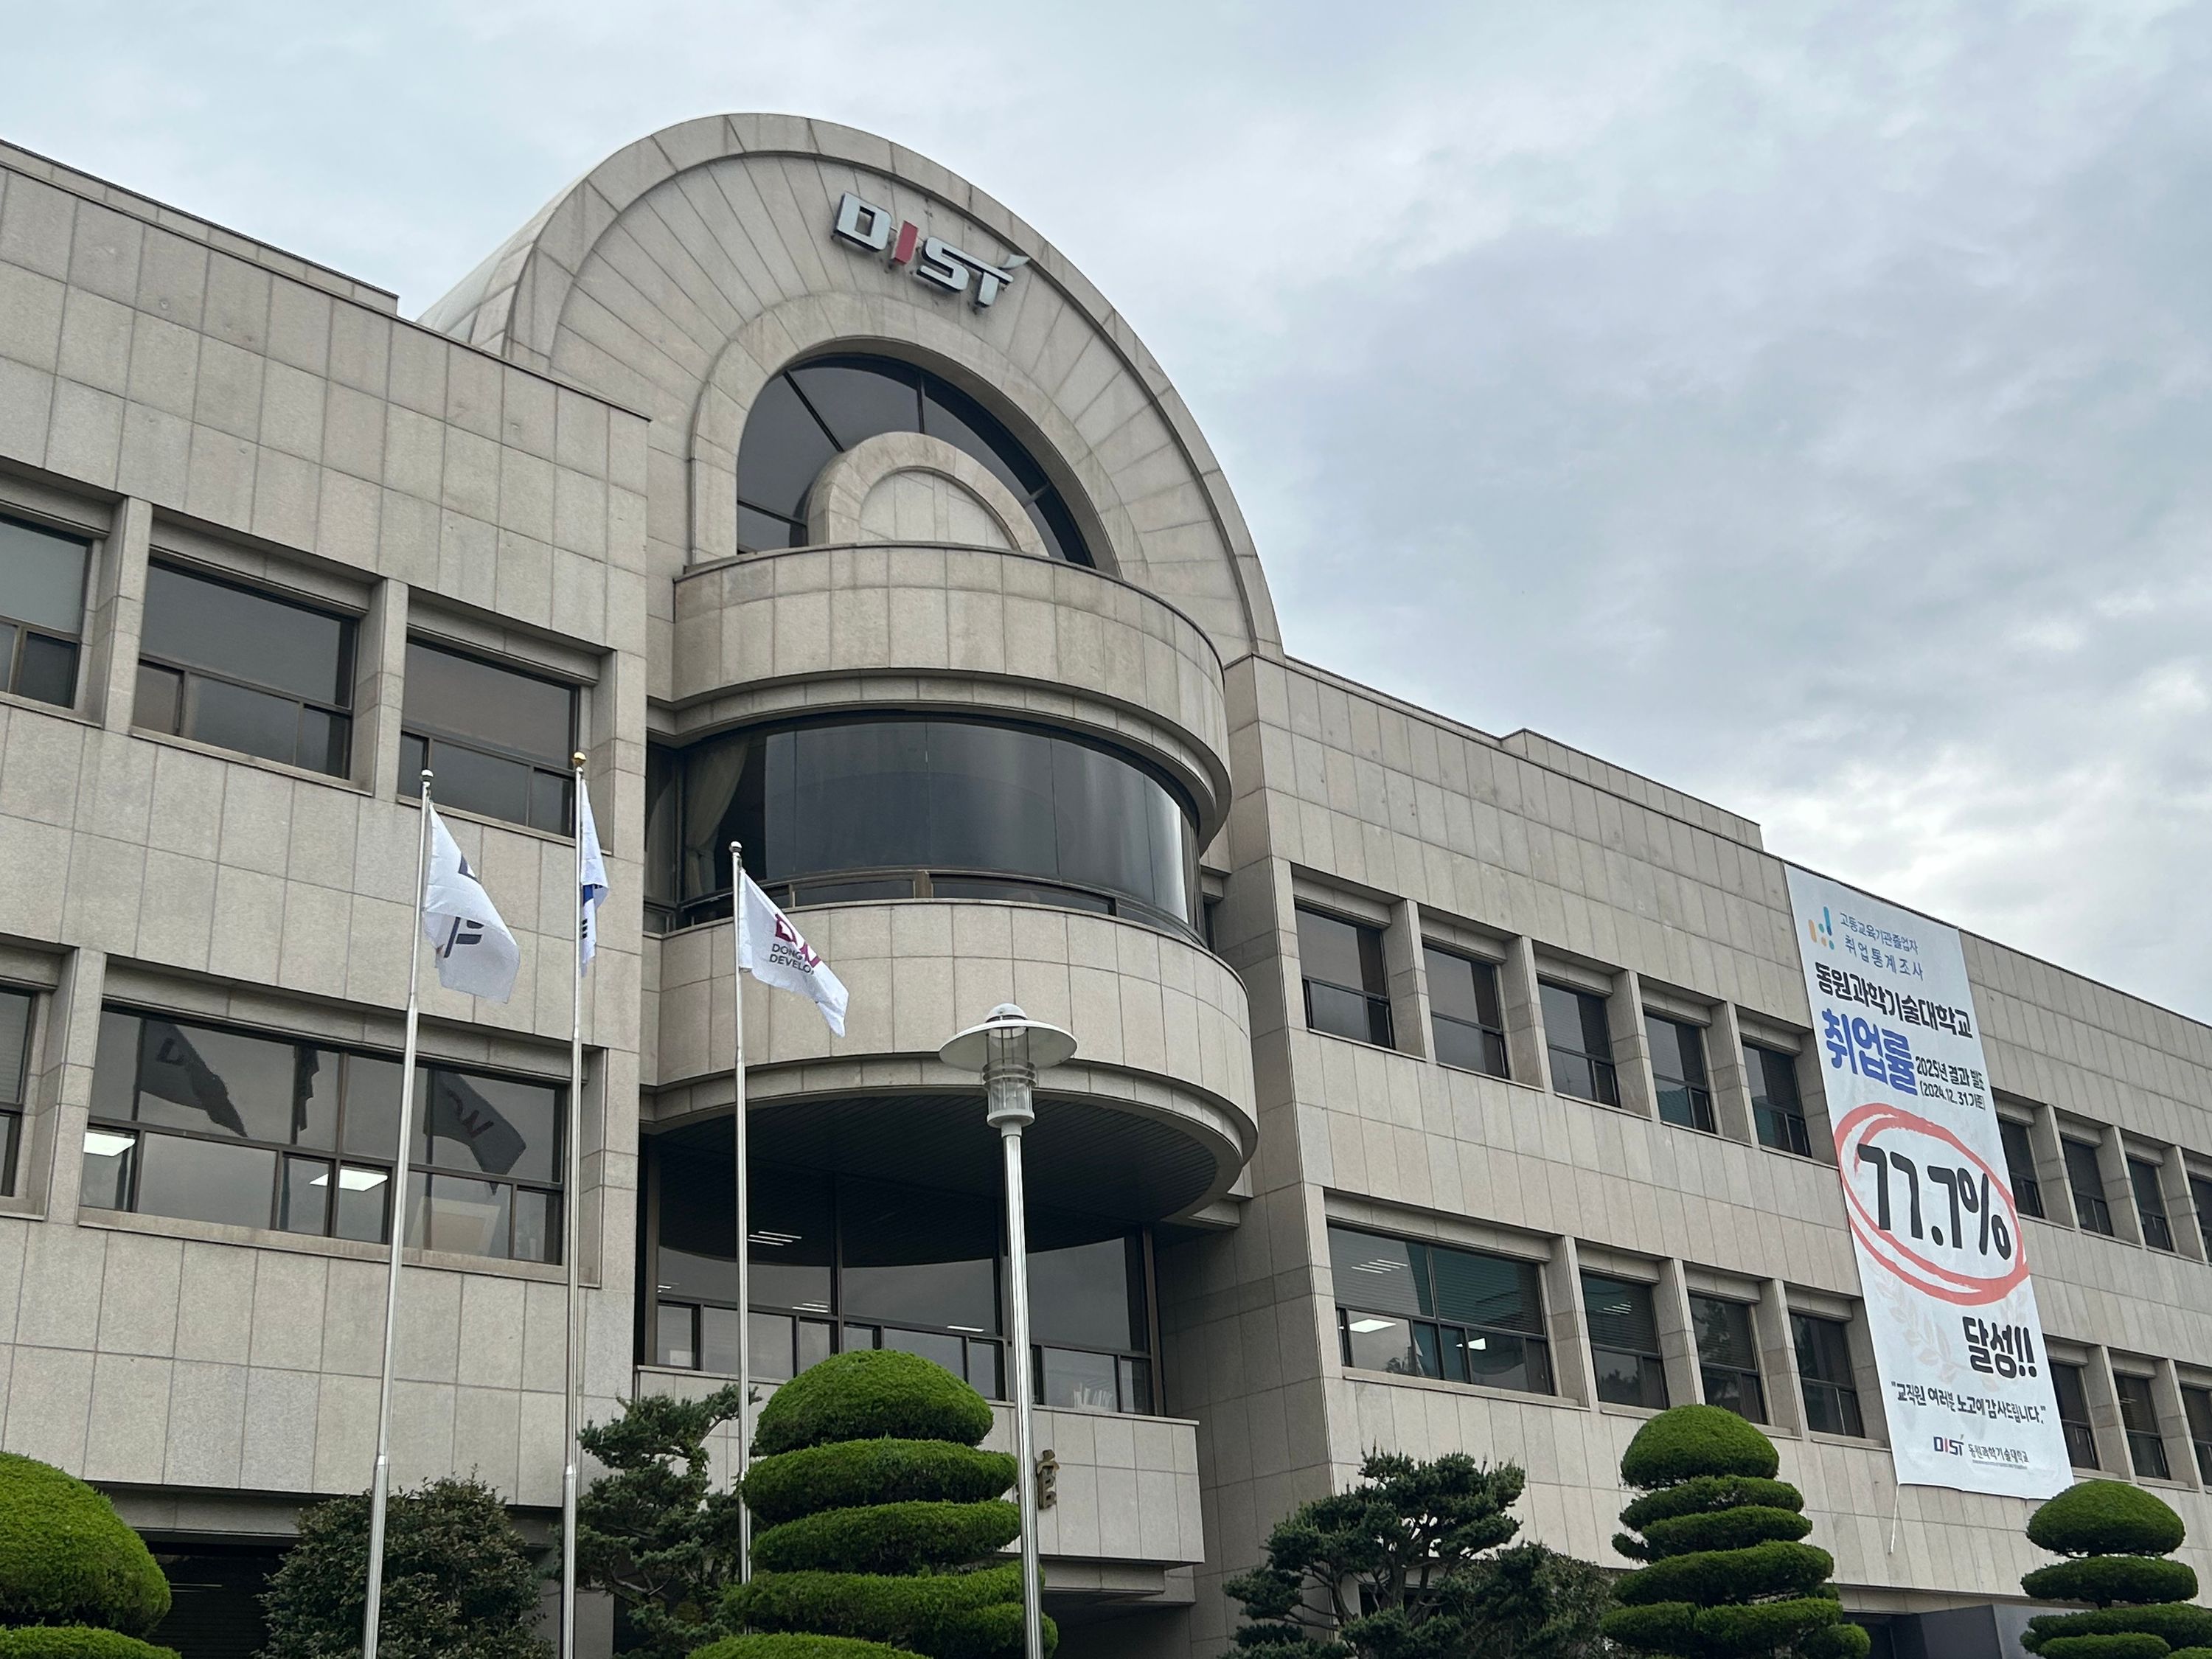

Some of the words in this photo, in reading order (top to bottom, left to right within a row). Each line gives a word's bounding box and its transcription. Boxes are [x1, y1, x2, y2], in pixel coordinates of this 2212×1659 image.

[834, 191, 1030, 307] DIST
[772, 943, 803, 960] DONG
[1840, 912, 1918, 955] 고등교육기관졸업자
[769, 953, 814, 975] DEVELO
[1815, 961, 1973, 1038] 동원과학기술대학교
[1822, 1008, 1918, 1096] 취업률
[1916, 1056, 1948, 1082] 2025년
[1948, 1065, 1970, 1087] 결과
[1857, 1143, 2011, 1260] 77.7%
[1962, 1316, 2037, 1379] 달성!!
[1927, 1387, 1956, 1412] 여러분
[1957, 1394, 1986, 1416] 노고에
[1933, 1435, 1964, 1456] DIST
